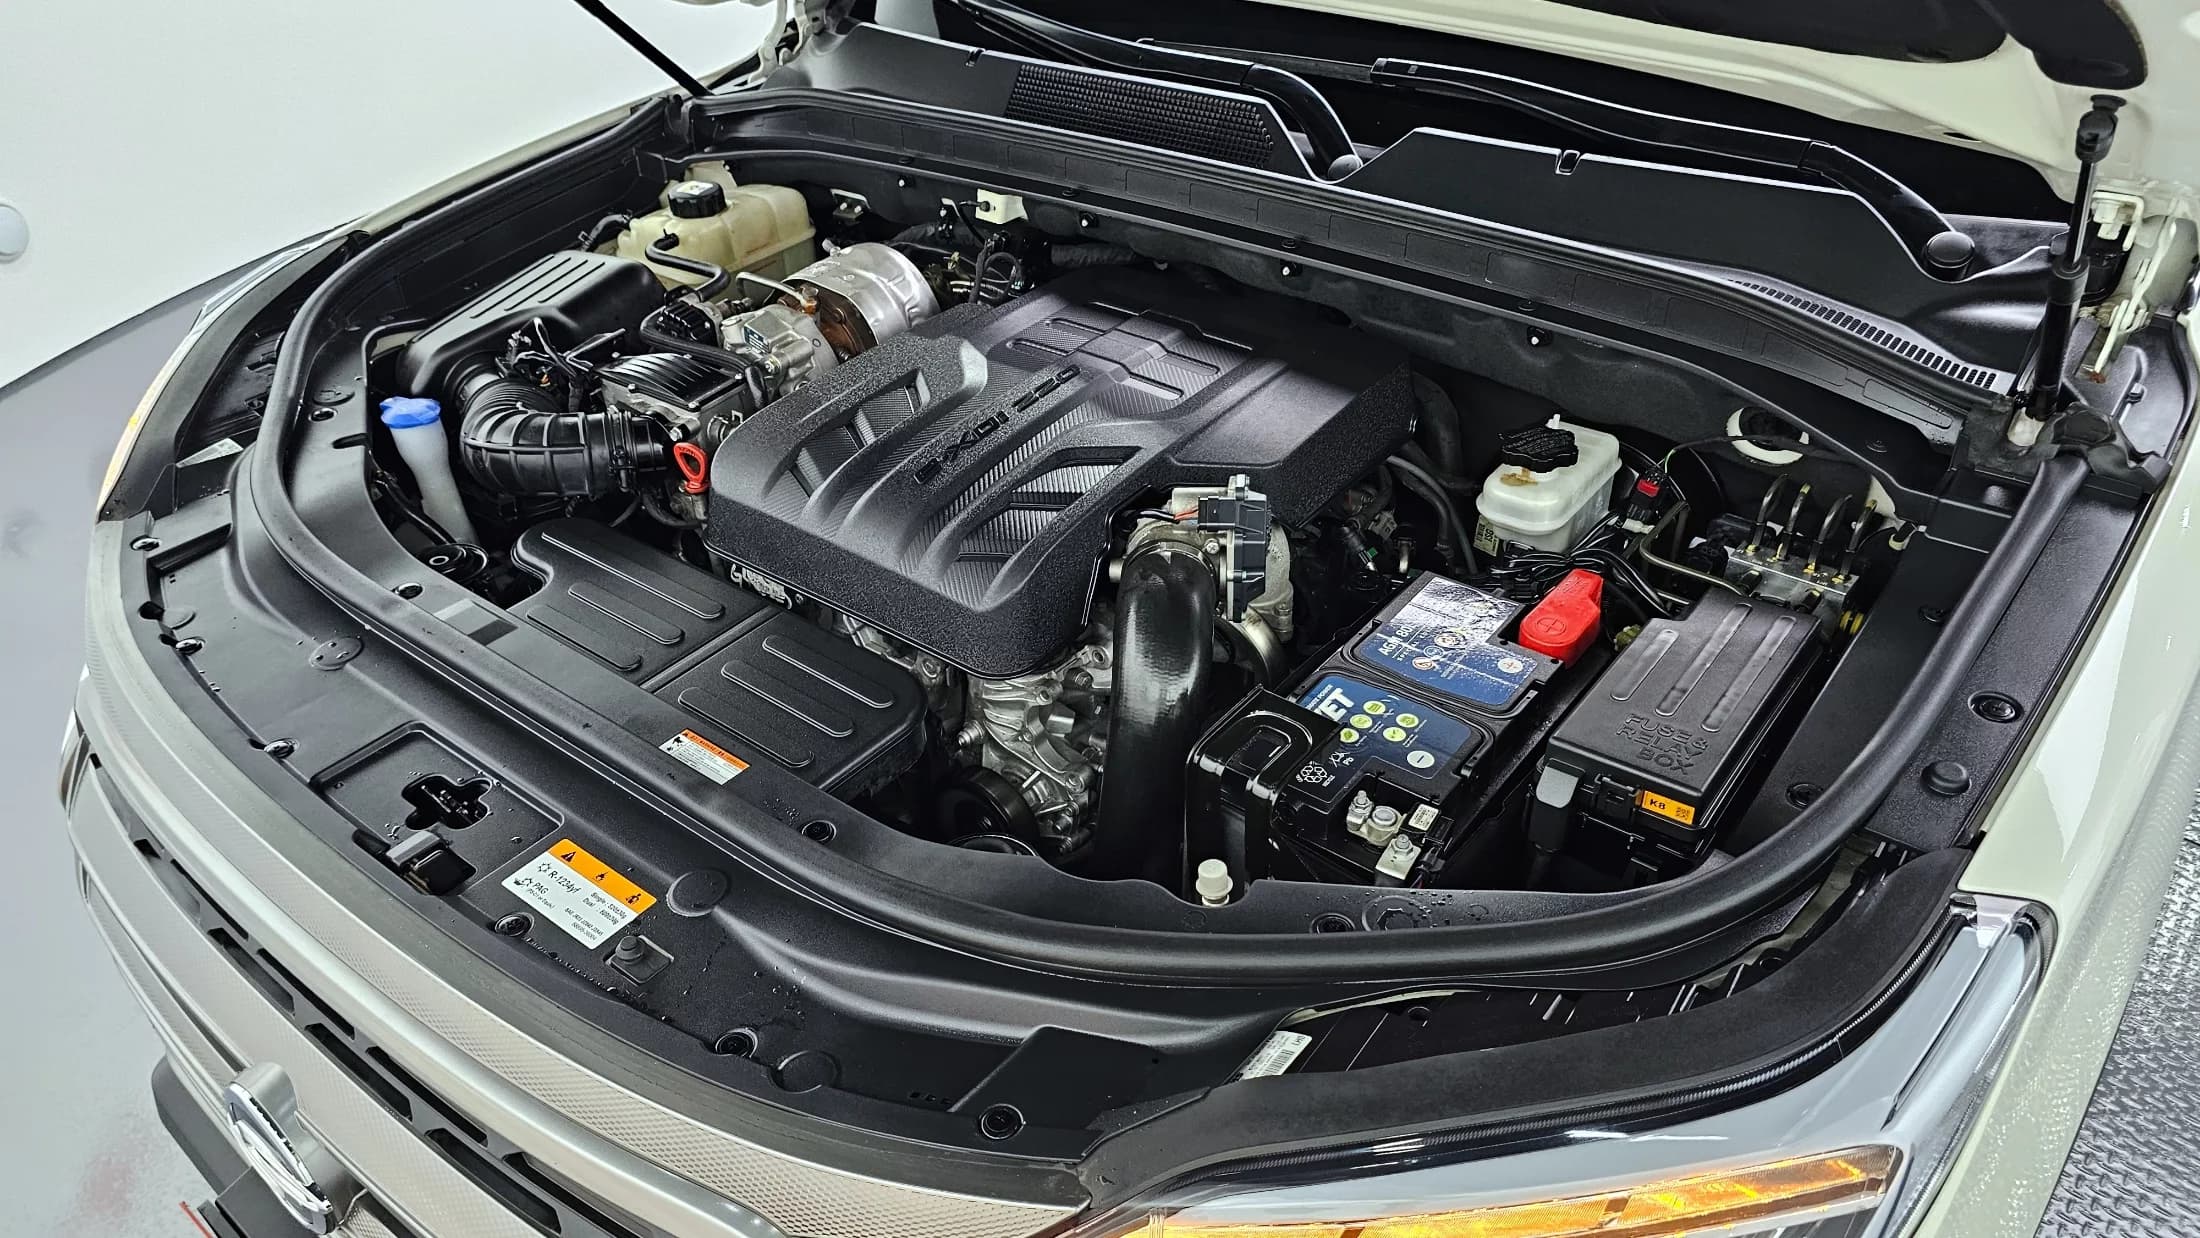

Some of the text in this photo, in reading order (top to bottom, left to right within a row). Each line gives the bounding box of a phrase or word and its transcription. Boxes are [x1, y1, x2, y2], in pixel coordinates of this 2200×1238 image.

[1378, 636, 1403, 656] AGM
[1616, 723, 1703, 761] RELAY
[1625, 713, 1708, 751] FUSE &
[1636, 747, 1694, 775] BOX
[532, 882, 549, 895] PAG
[548, 870, 582, 894] R-1234yf
